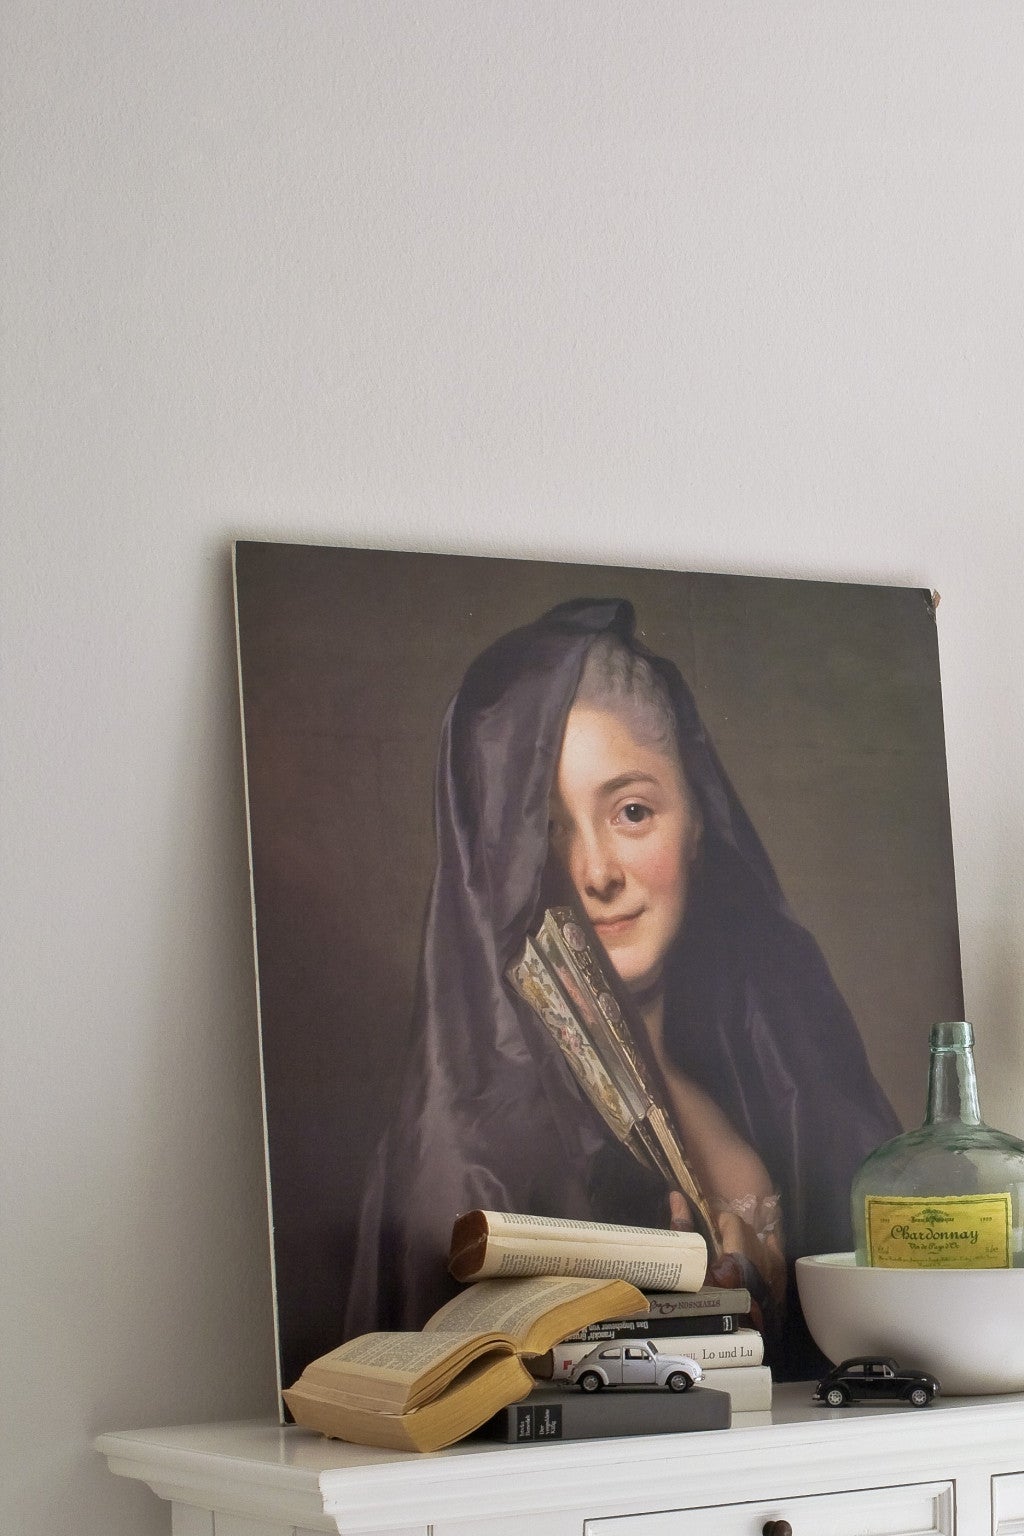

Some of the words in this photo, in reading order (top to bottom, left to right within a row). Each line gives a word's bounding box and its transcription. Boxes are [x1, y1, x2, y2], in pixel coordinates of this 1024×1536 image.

[890, 1224, 979, 1245] Chardonnay
[678, 1299, 721, 1310] STEVENSON
[601, 1321, 635, 1331] Ungeheuer
[635, 1320, 649, 1330] Das
[702, 1349, 716, 1360] Lo
[718, 1347, 738, 1359] und
[740, 1346, 754, 1357] Lu
